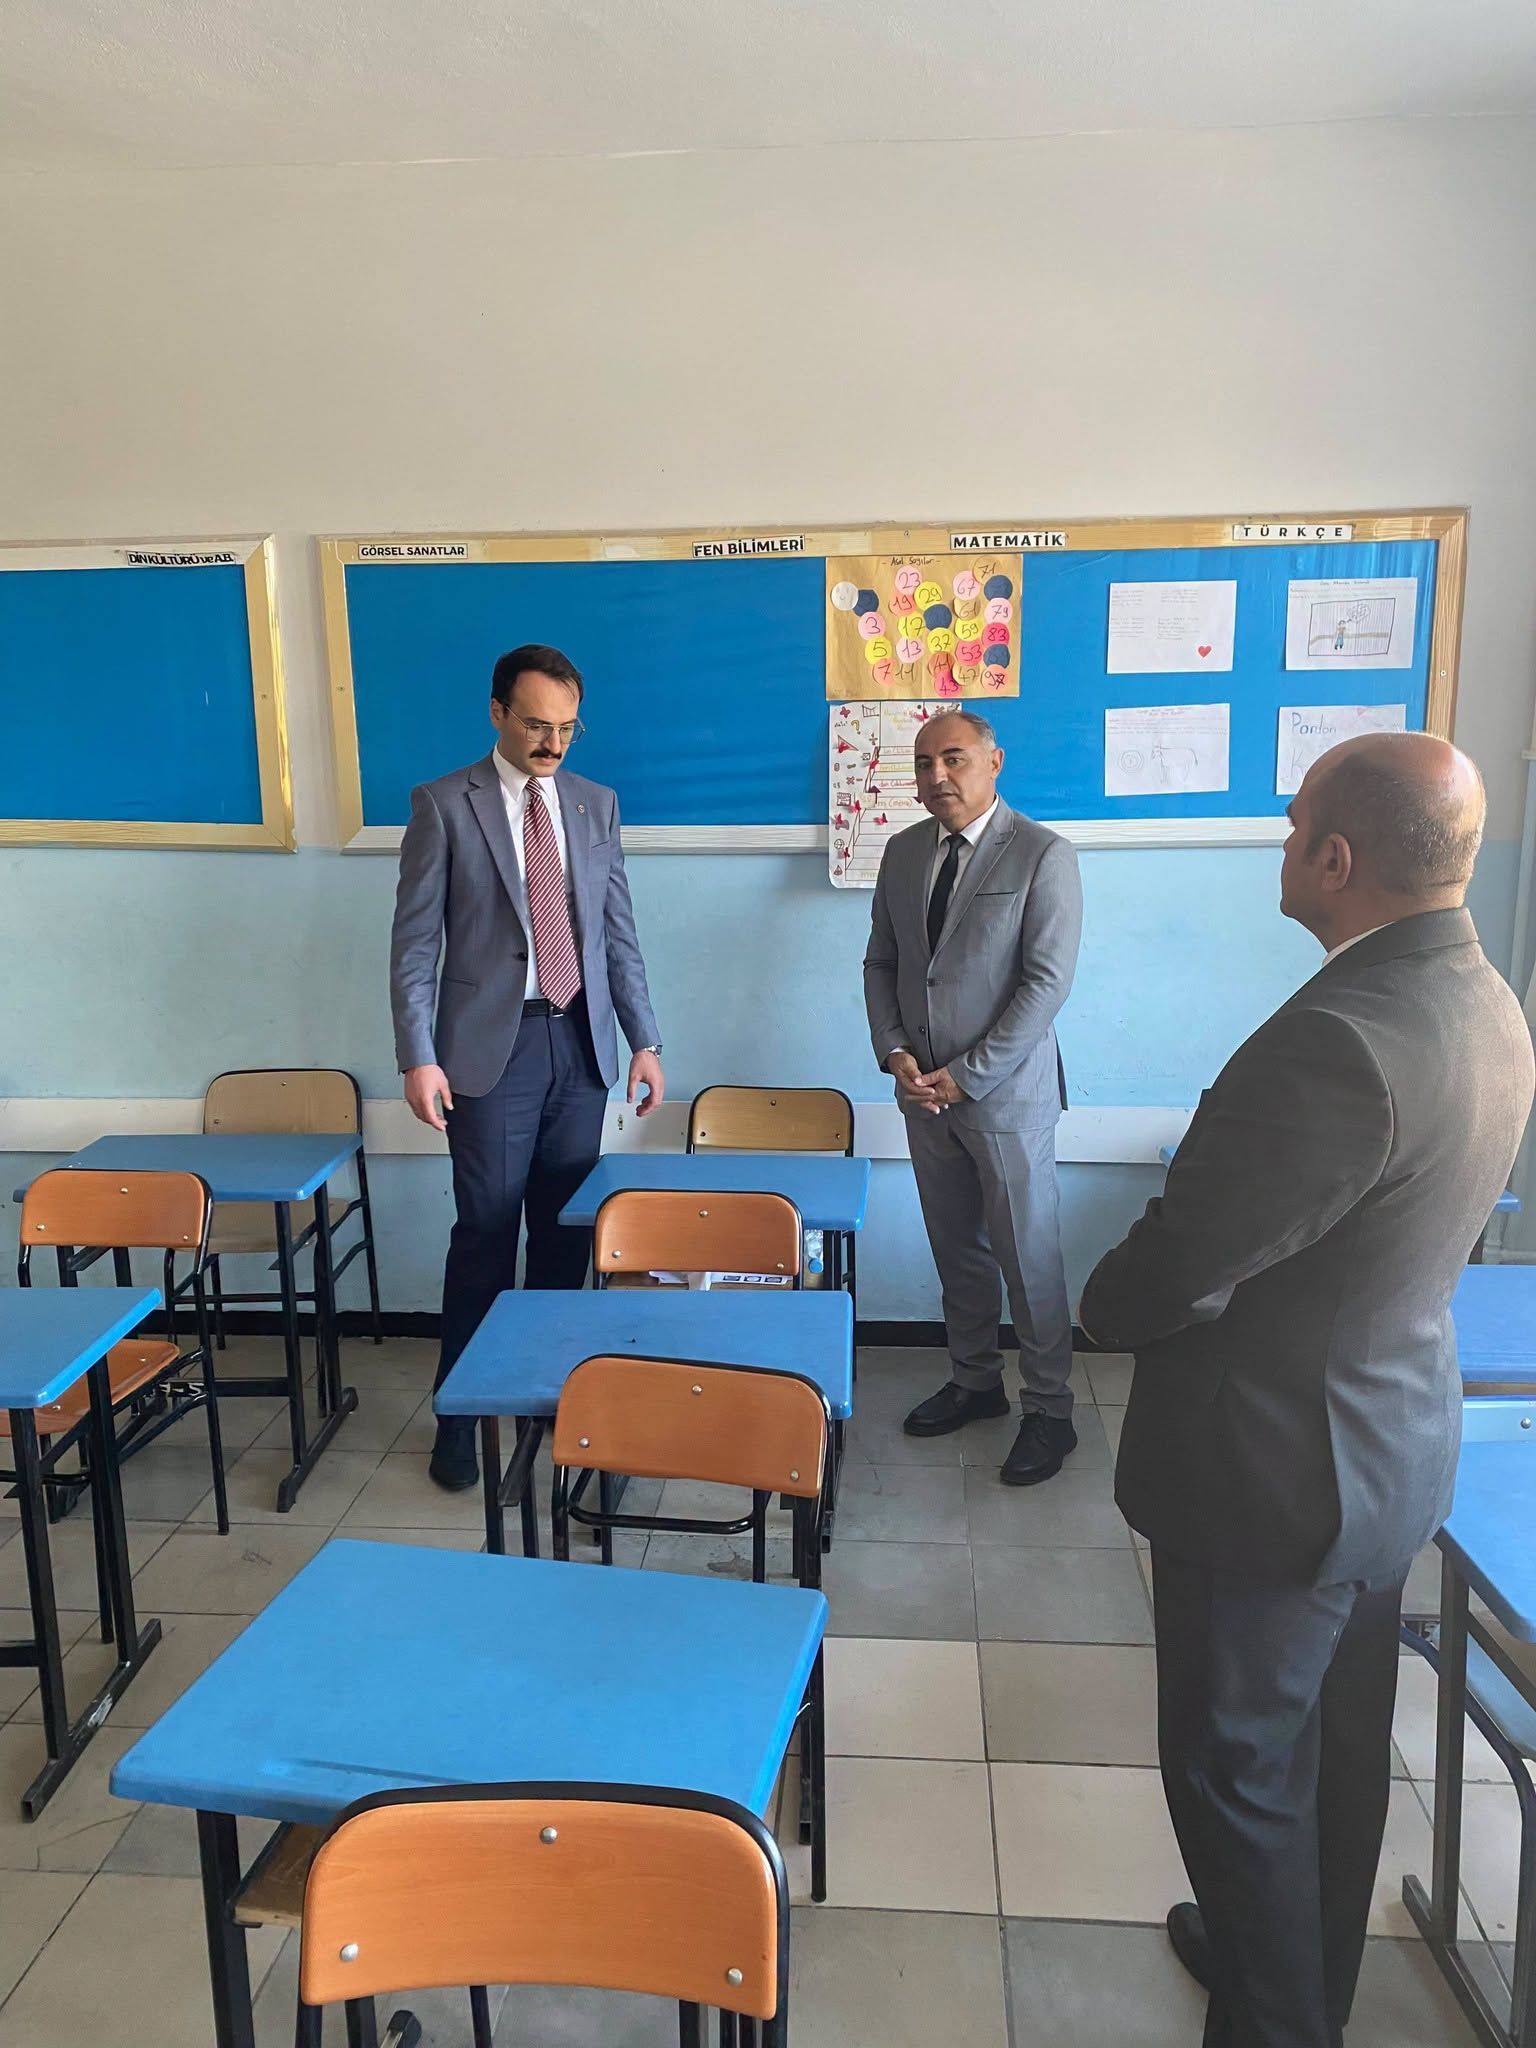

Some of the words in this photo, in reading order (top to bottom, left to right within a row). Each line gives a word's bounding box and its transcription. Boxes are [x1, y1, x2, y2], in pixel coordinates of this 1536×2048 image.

[953, 532, 1064, 548] MATEMATİK
[1243, 525, 1343, 539] TÜRKÇE
[361, 544, 404, 558] GÖRSEL
[407, 546, 465, 556] SANATLAR
[694, 543, 723, 557] FEN
[727, 535, 805, 554] BİLİMLERİ
[129, 552, 148, 563] DİN
[148, 553, 200, 565] KÜLTÜRÜ
[978, 562, 997, 579] 71
[899, 571, 920, 589] 23
[957, 578, 976, 597] 67
[892, 595, 912, 611] 19
[919, 587, 942, 603] 29
[960, 602, 977, 618] 61
[992, 605, 1009, 619] 79
[865, 617, 880, 634] 3
[903, 617, 924, 637] 17
[962, 622, 979, 639] 59
[930, 634, 951, 650] 37
[987, 628, 1007, 641] 83
[872, 642, 887, 657] 5
[902, 640, 921, 658] 13
[961, 644, 982, 661] 53
[878, 664, 891, 680] 7
[959, 667, 979, 682] 47
[939, 677, 959, 695] 43
